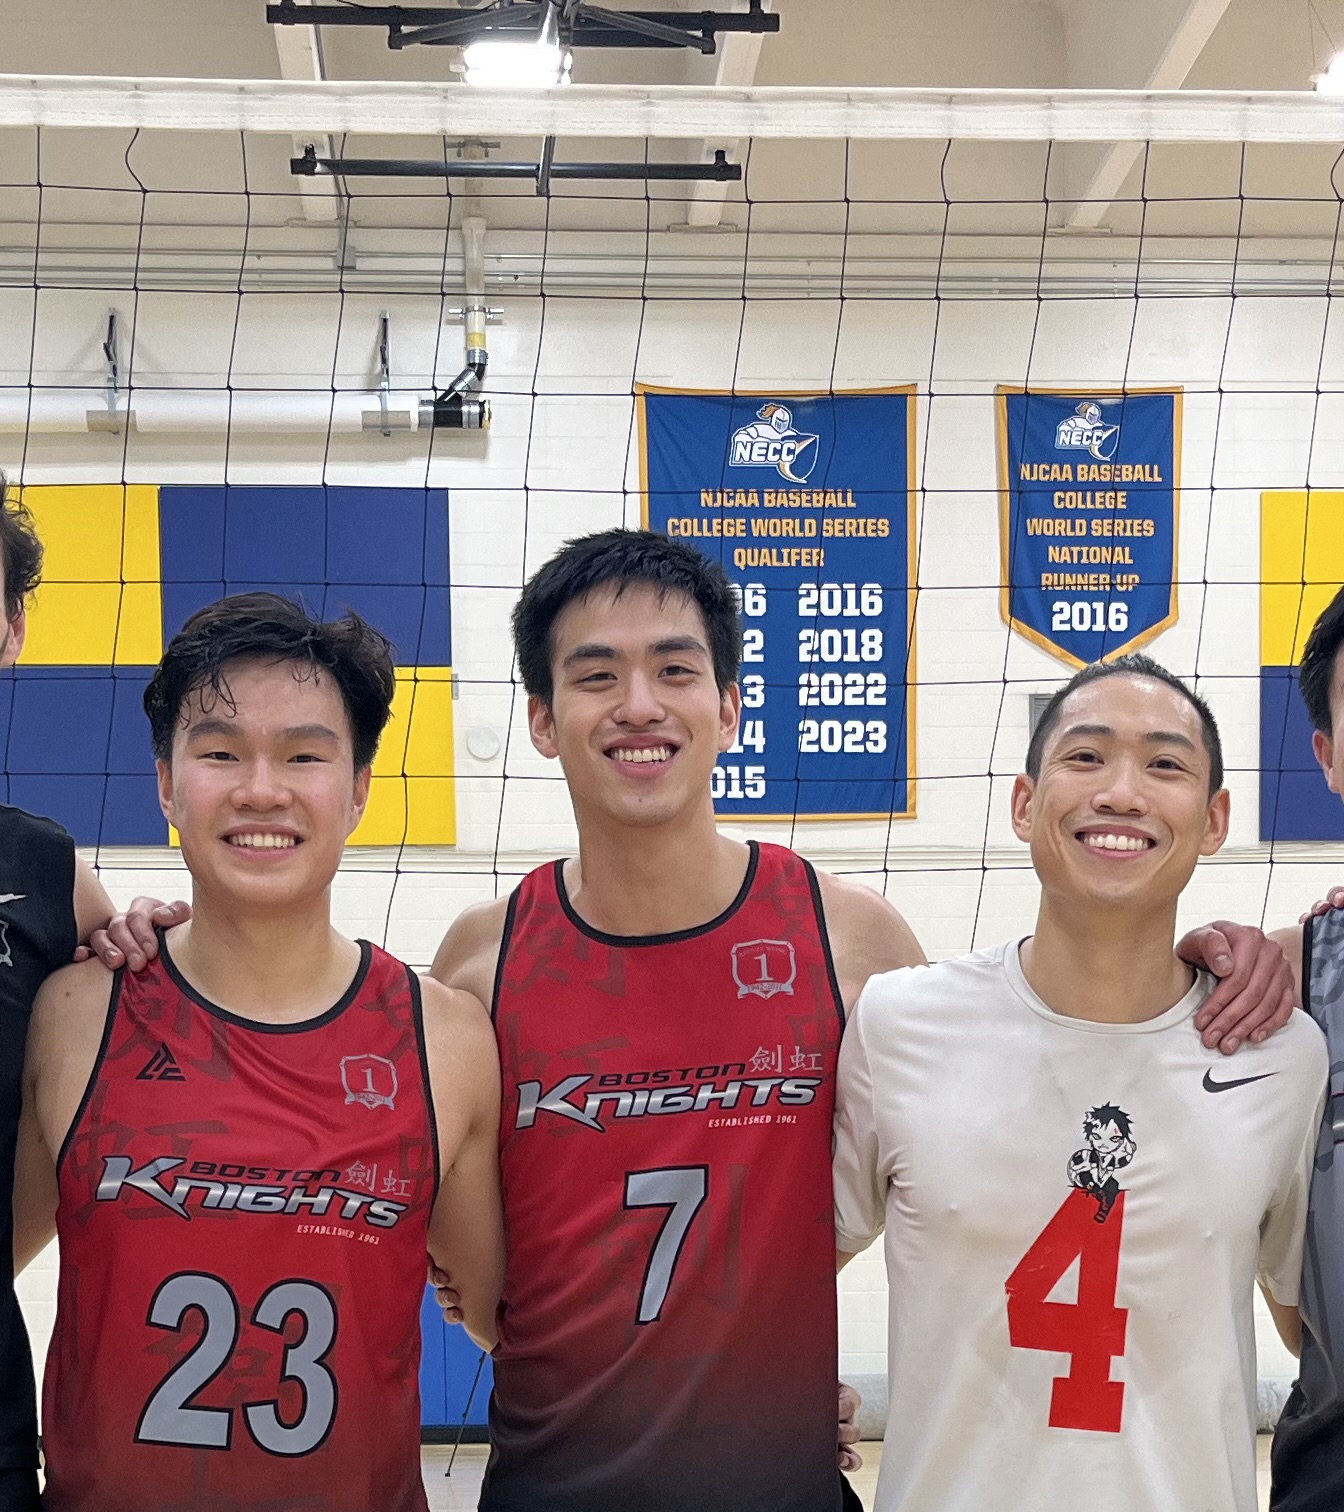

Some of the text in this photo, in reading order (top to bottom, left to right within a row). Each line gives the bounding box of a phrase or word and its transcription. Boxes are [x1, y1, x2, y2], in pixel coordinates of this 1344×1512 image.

[1058, 430, 1104, 447] NECC
[735, 440, 796, 463] NECC
[1020, 463, 1163, 482] NJCAA BASEBALL
[700, 489, 856, 508] NJCAA BASEBALL
[1053, 491, 1127, 509] COLLEGE
[667, 518, 890, 538] COLLEGE WORLD SERIES
[1026, 518, 1154, 537] WORLD SERIES
[1048, 546, 1134, 564] NATIONAL
[1041, 573, 1140, 592] RUNNER-UP
[798, 583, 883, 617] 2016
[1052, 601, 1128, 632] 2016
[798, 629, 883, 662] 2018
[798, 673, 887, 706] 2022
[798, 720, 887, 753] 2023
[710, 765, 766, 799] 015
[753, 953, 774, 981] 1
[361, 1068, 378, 1093] 1
[598, 1063, 746, 1086] BOSTON
[708, 1115, 797, 1128] ESTABLISHED 1961
[189, 1161, 341, 1183] BOSTON
[297, 1224, 380, 1245] ESTABLISHED 1961
[623, 1164, 709, 1326] 7
[1004, 1186, 1128, 1433] 4
[132, 1270, 339, 1458] 23
